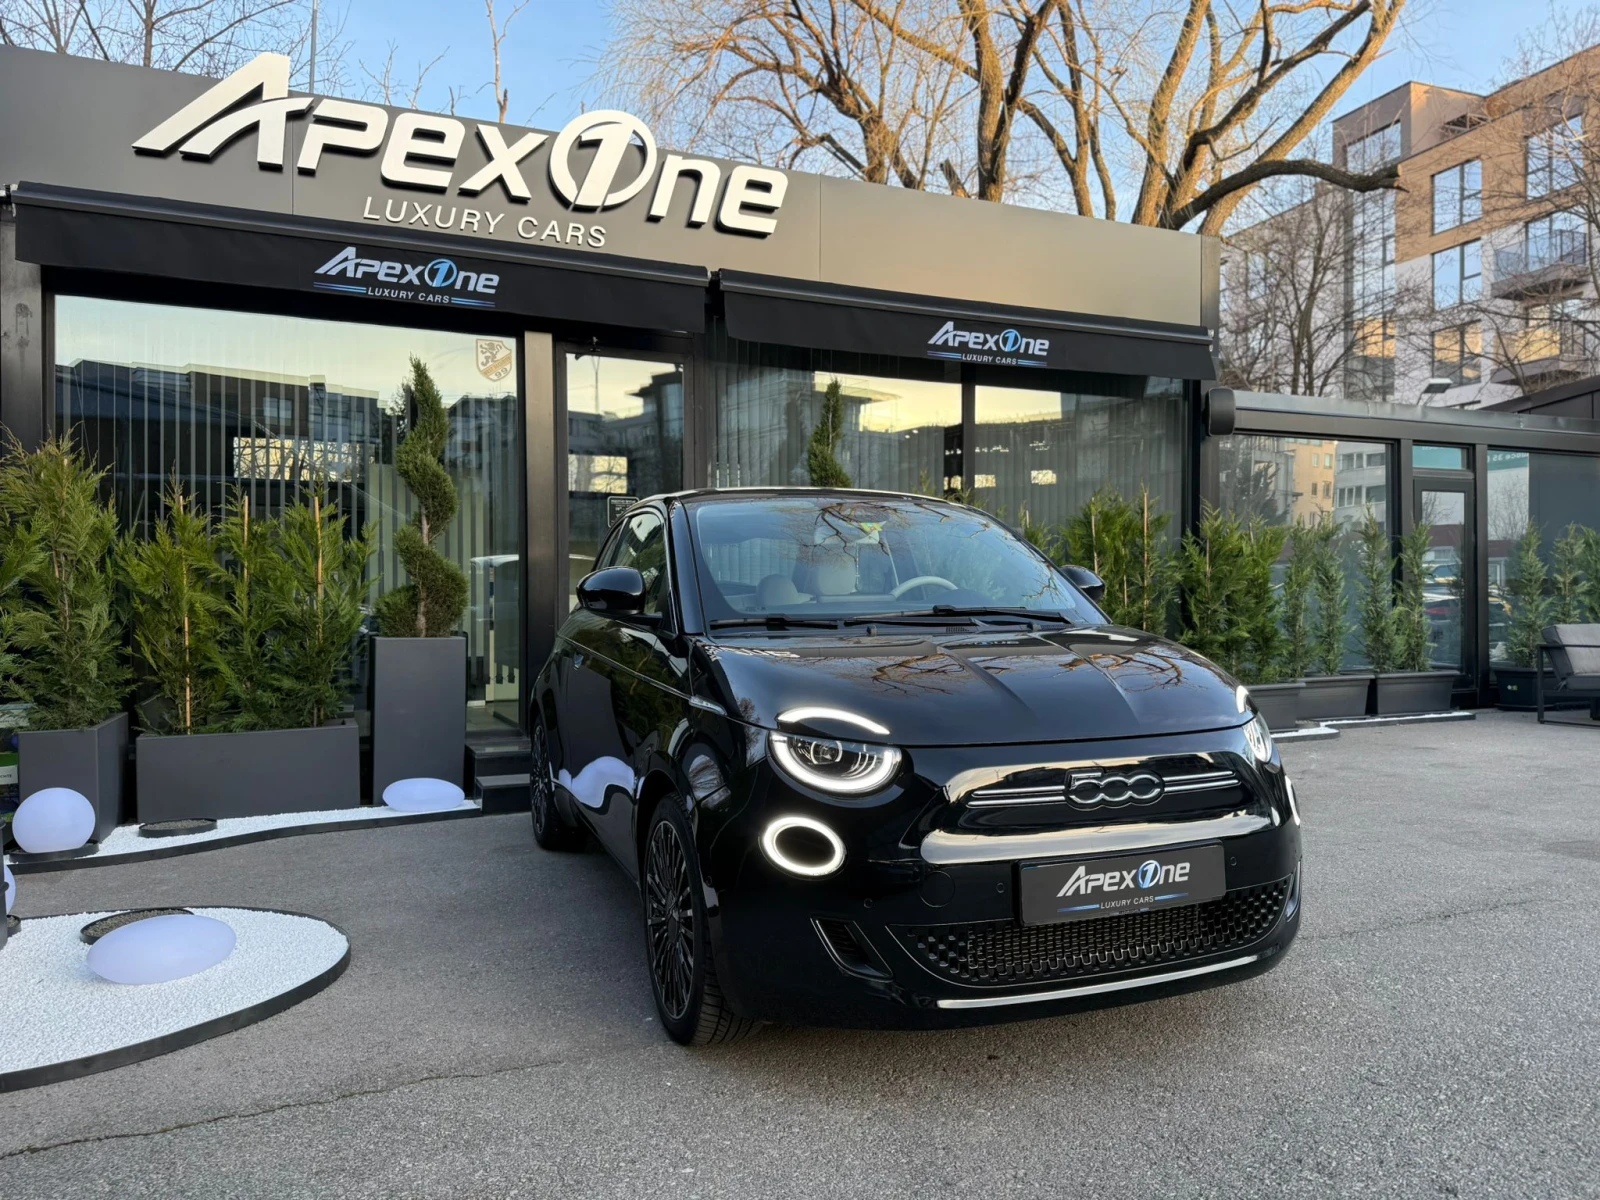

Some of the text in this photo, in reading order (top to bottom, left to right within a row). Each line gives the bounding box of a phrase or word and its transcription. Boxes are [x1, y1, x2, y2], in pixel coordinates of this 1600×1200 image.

[363, 196, 607, 248] LUXURY CARS
[368, 287, 450, 304] LUXURY CARS
[962, 353, 1017, 365] LUXURY CARS
[1068, 771, 1161, 804] 500
[1100, 895, 1154, 910] LUXURY CARS
